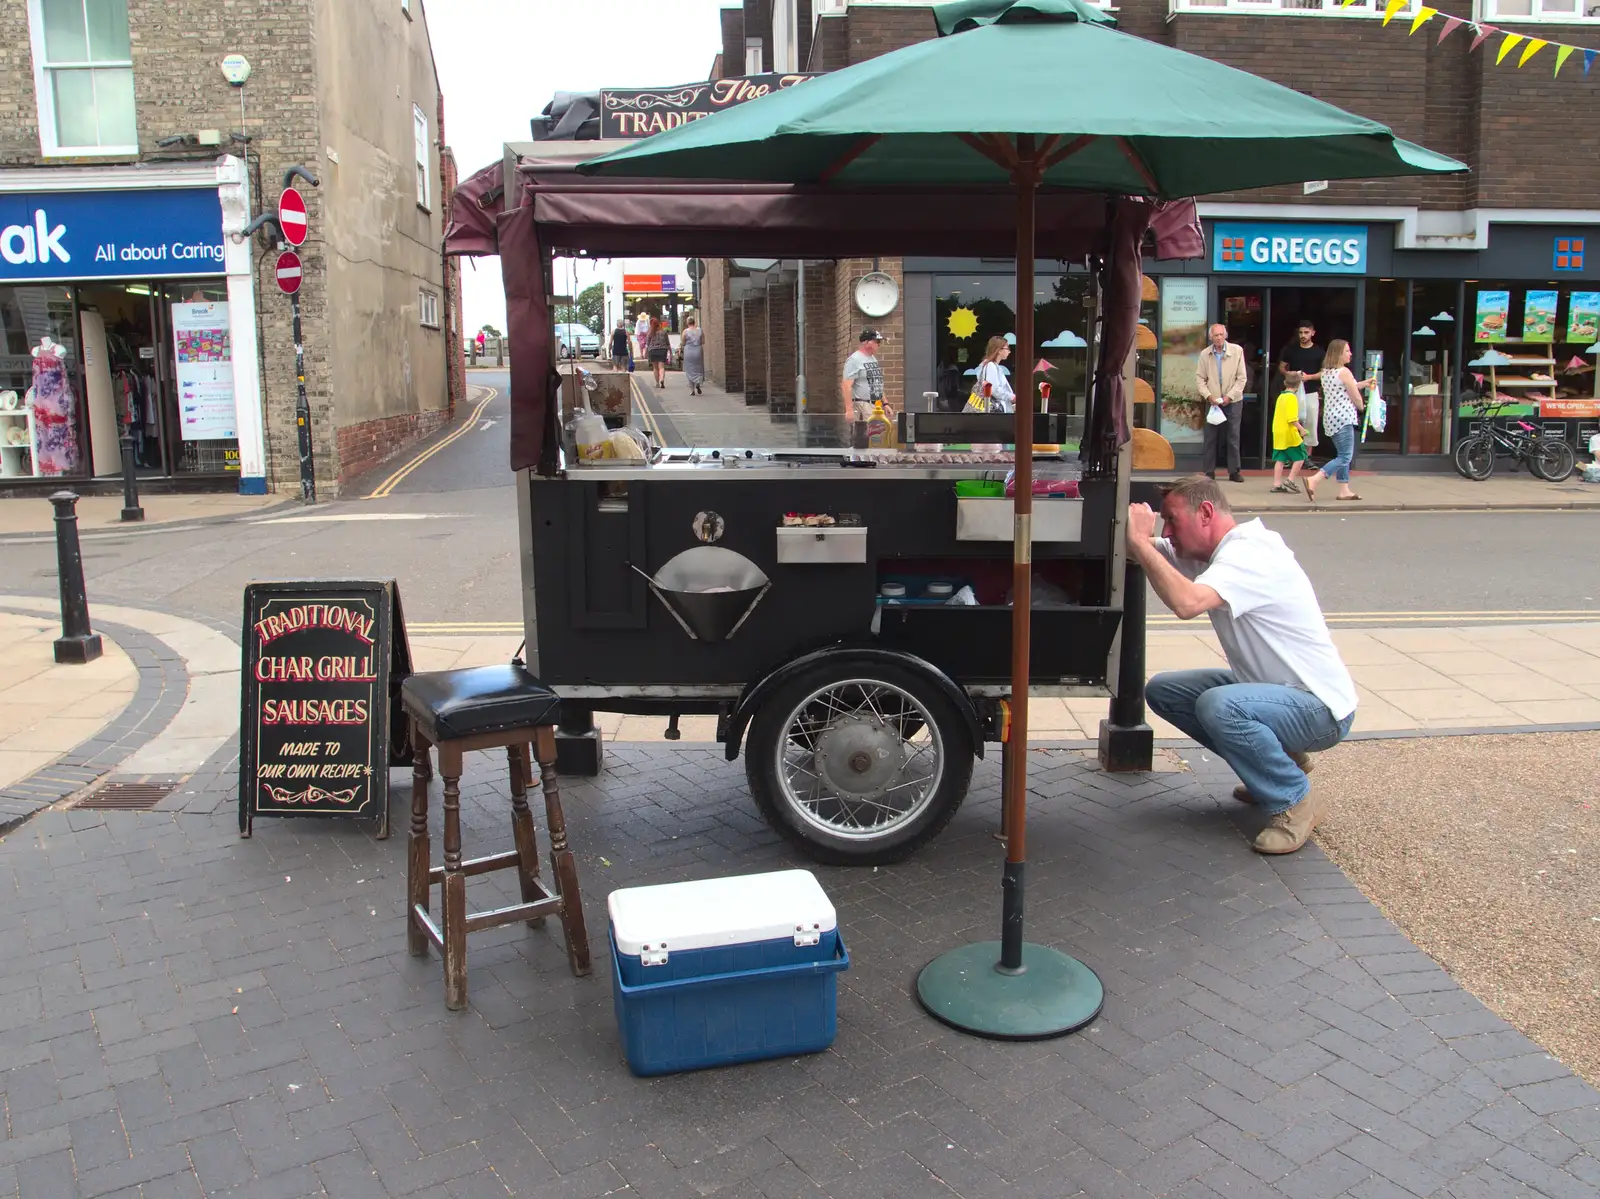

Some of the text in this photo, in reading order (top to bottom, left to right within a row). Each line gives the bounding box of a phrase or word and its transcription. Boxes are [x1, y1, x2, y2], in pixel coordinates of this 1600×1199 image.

[710, 79, 770, 106] The
[612, 111, 714, 136] TRADI
[0, 208, 71, 264] ak
[95, 242, 225, 262] All about Caring
[1250, 237, 1360, 265] GREGGS
[254, 604, 376, 647] TRADITIONAL
[255, 656, 377, 682] CHAR GRILL
[262, 699, 368, 725] SAUSAGES
[279, 741, 341, 756] MADE TO
[257, 764, 287, 778] OUR
[286, 764, 319, 778] OWN
